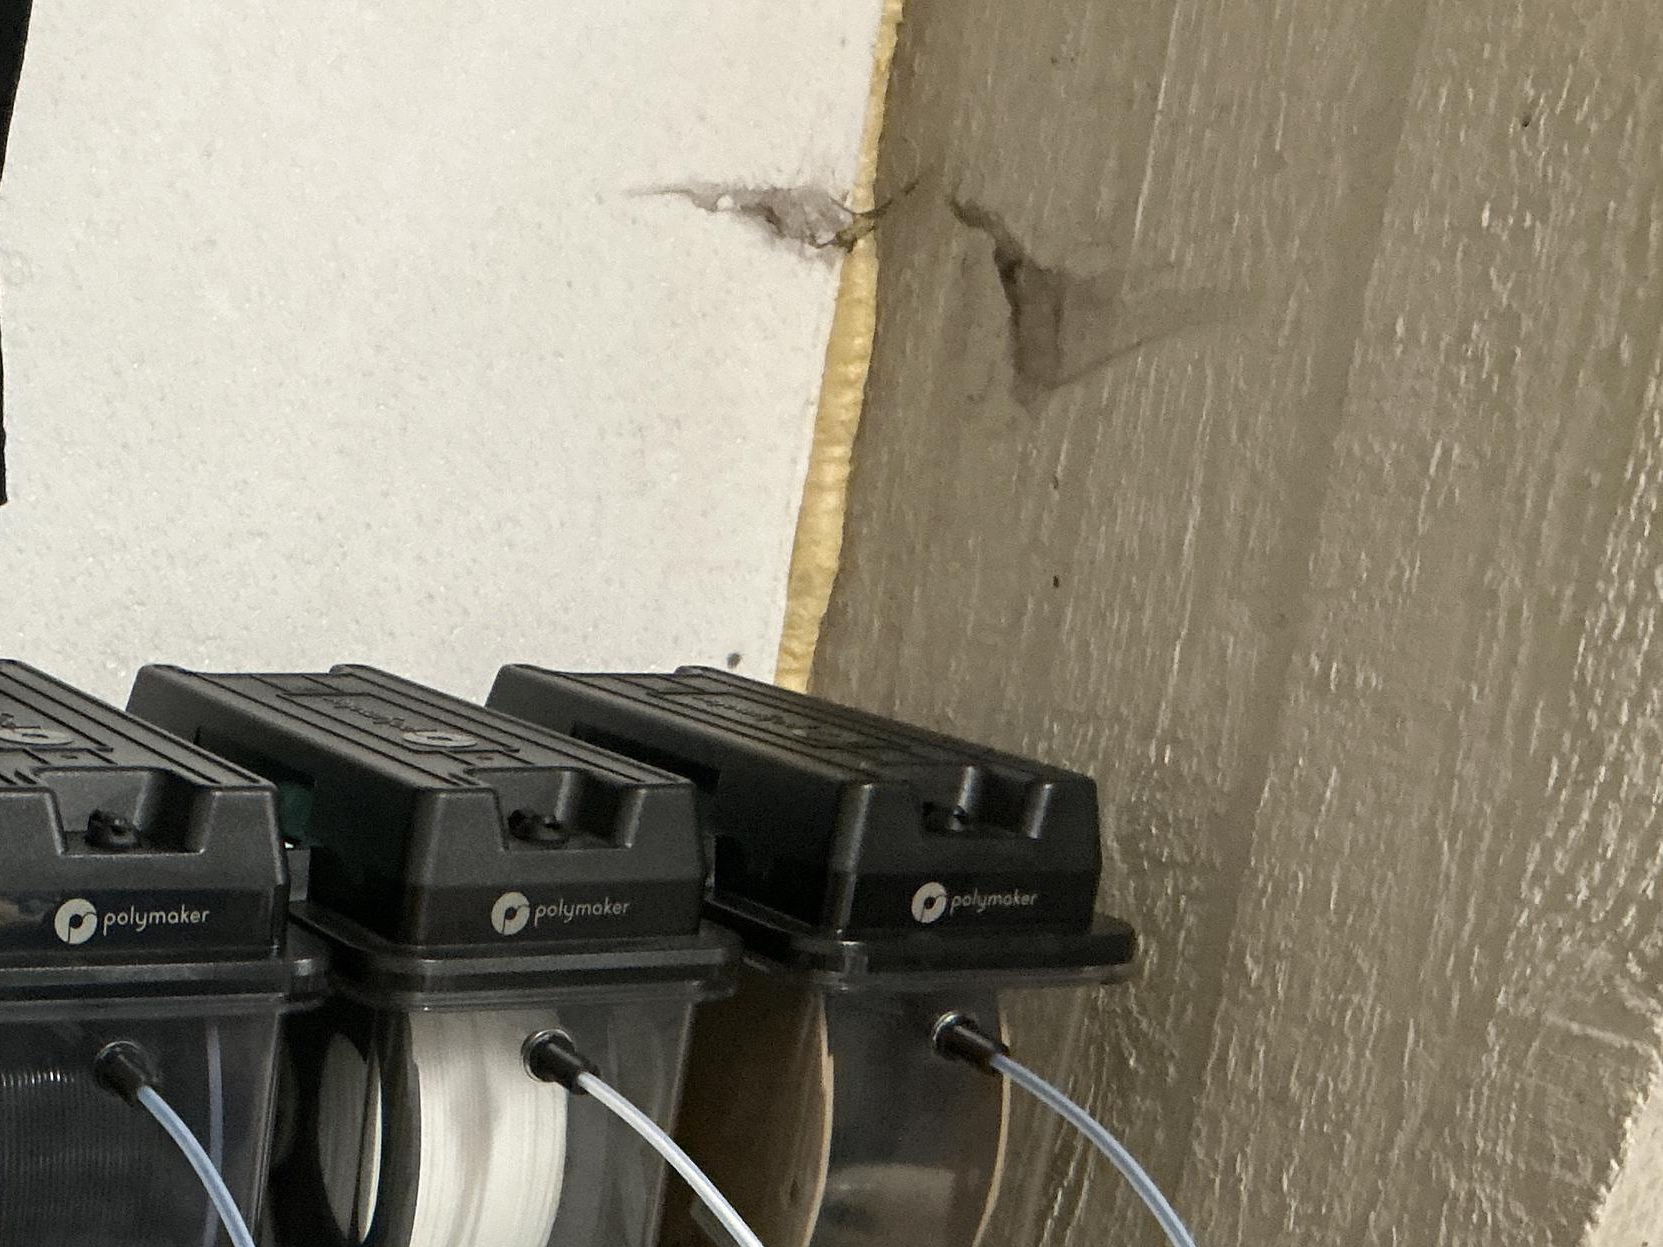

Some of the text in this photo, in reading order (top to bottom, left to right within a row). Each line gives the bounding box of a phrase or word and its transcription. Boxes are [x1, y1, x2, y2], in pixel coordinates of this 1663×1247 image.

[534, 897, 629, 928] polymaker
[951, 890, 1037, 917] polymaker
[103, 906, 210, 936] polymaker
